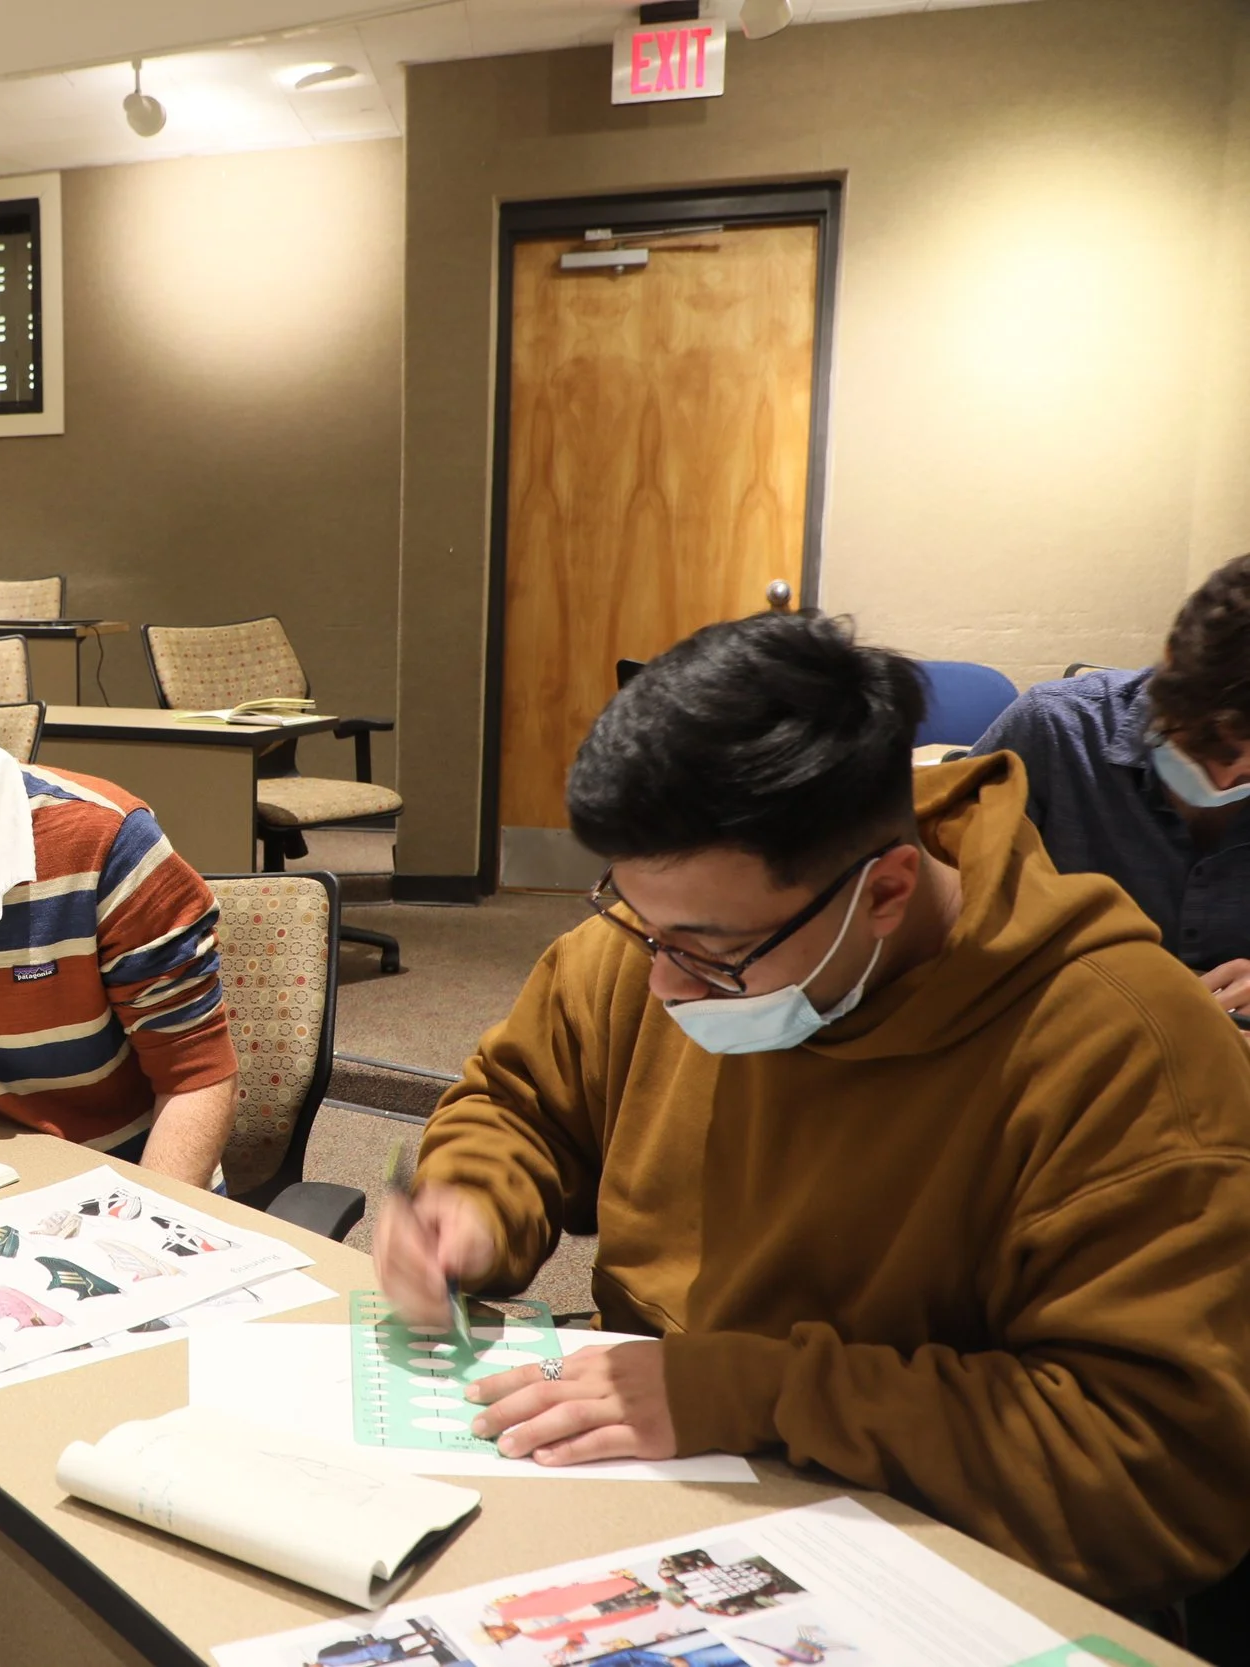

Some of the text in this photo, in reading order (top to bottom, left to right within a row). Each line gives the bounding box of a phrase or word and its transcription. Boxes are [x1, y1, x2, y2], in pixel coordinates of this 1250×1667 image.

[631, 27, 712, 94] EXIT
[17, 970, 53, 980] patagonia
[230, 1254, 281, 1274] Running
